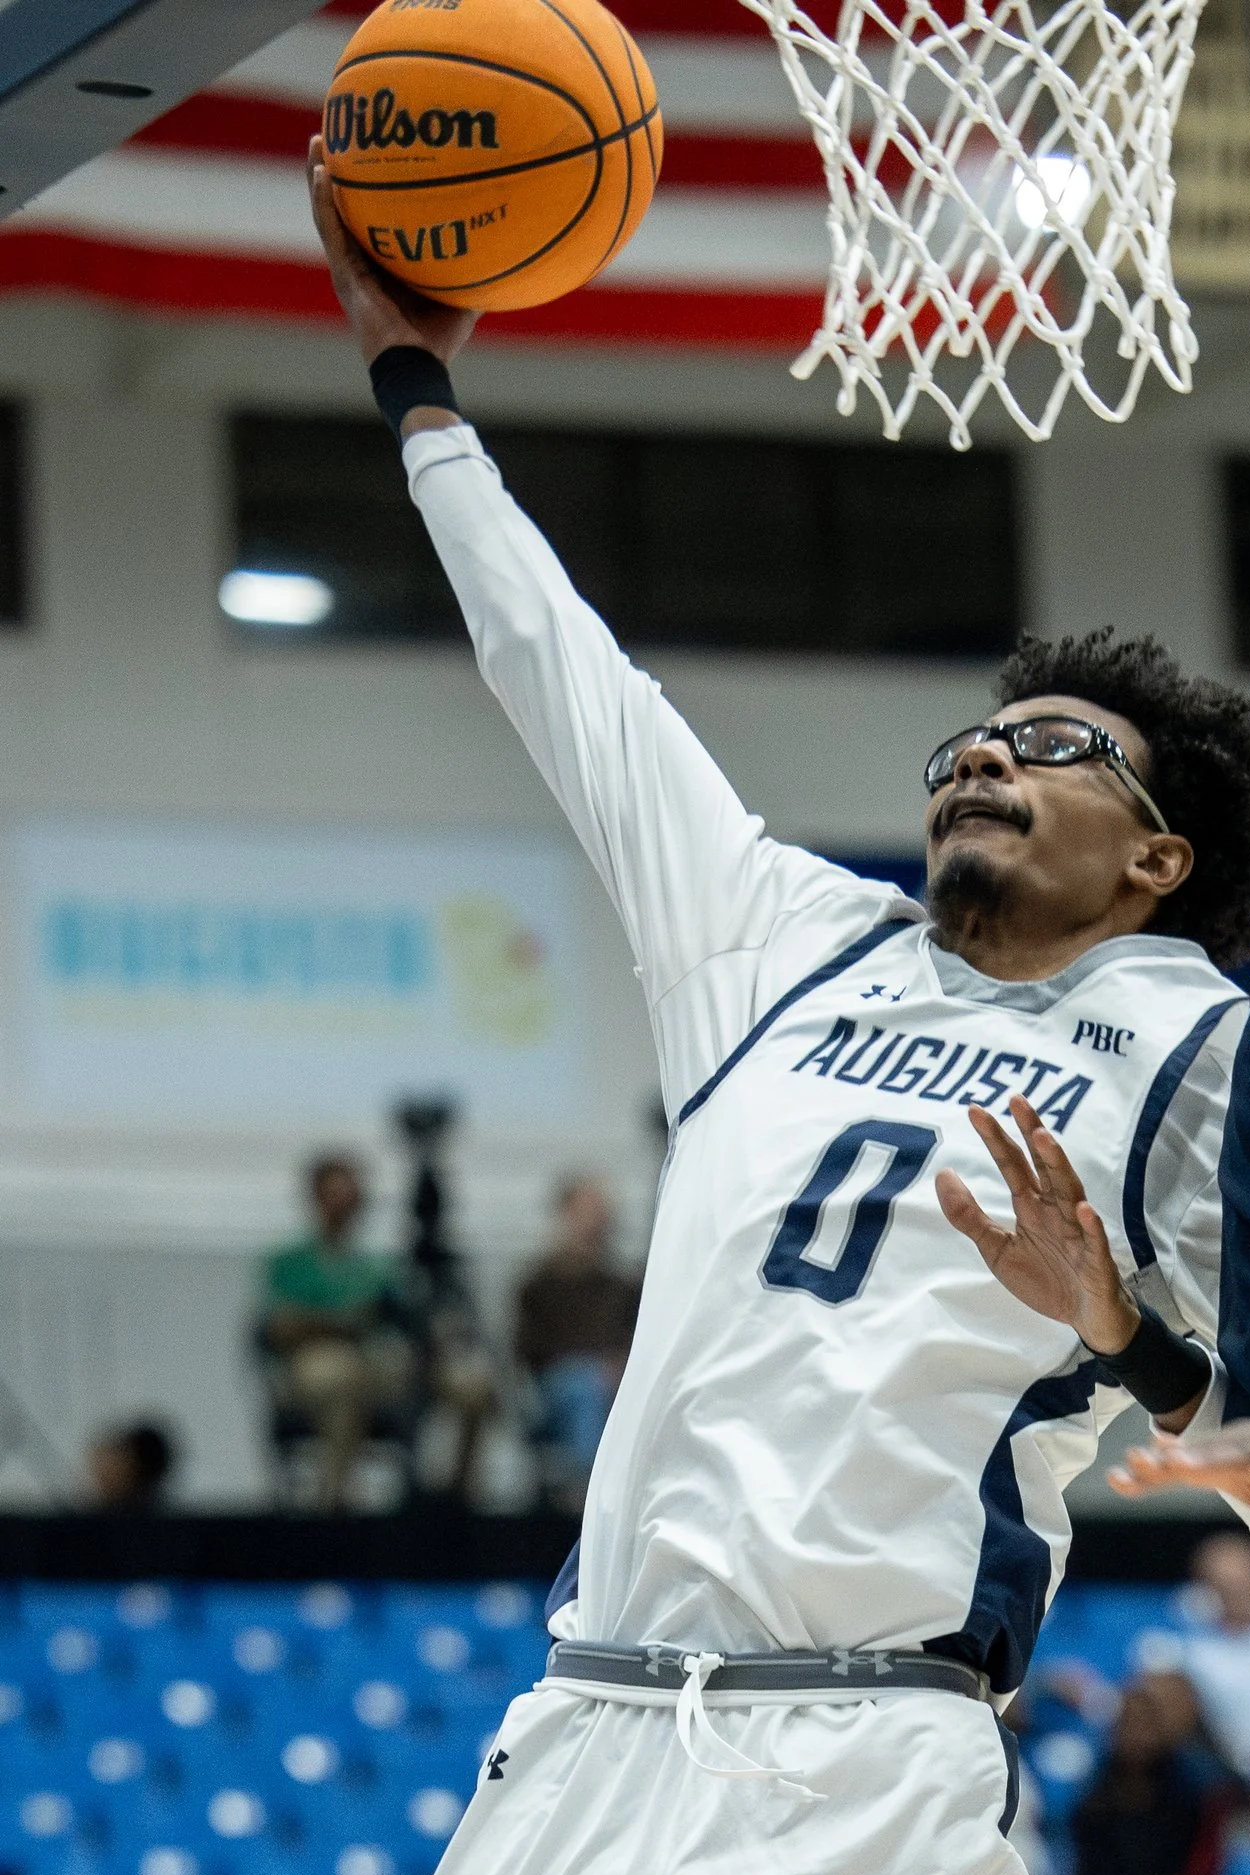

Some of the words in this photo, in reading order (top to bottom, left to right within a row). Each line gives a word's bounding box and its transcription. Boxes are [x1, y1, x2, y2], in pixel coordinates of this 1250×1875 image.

[326, 87, 499, 154] Wilson
[367, 220, 468, 261] EVO
[1071, 1019, 1135, 1057] PBC
[790, 1016, 1095, 1135] AUGUSTA
[757, 1116, 944, 1309] 0
